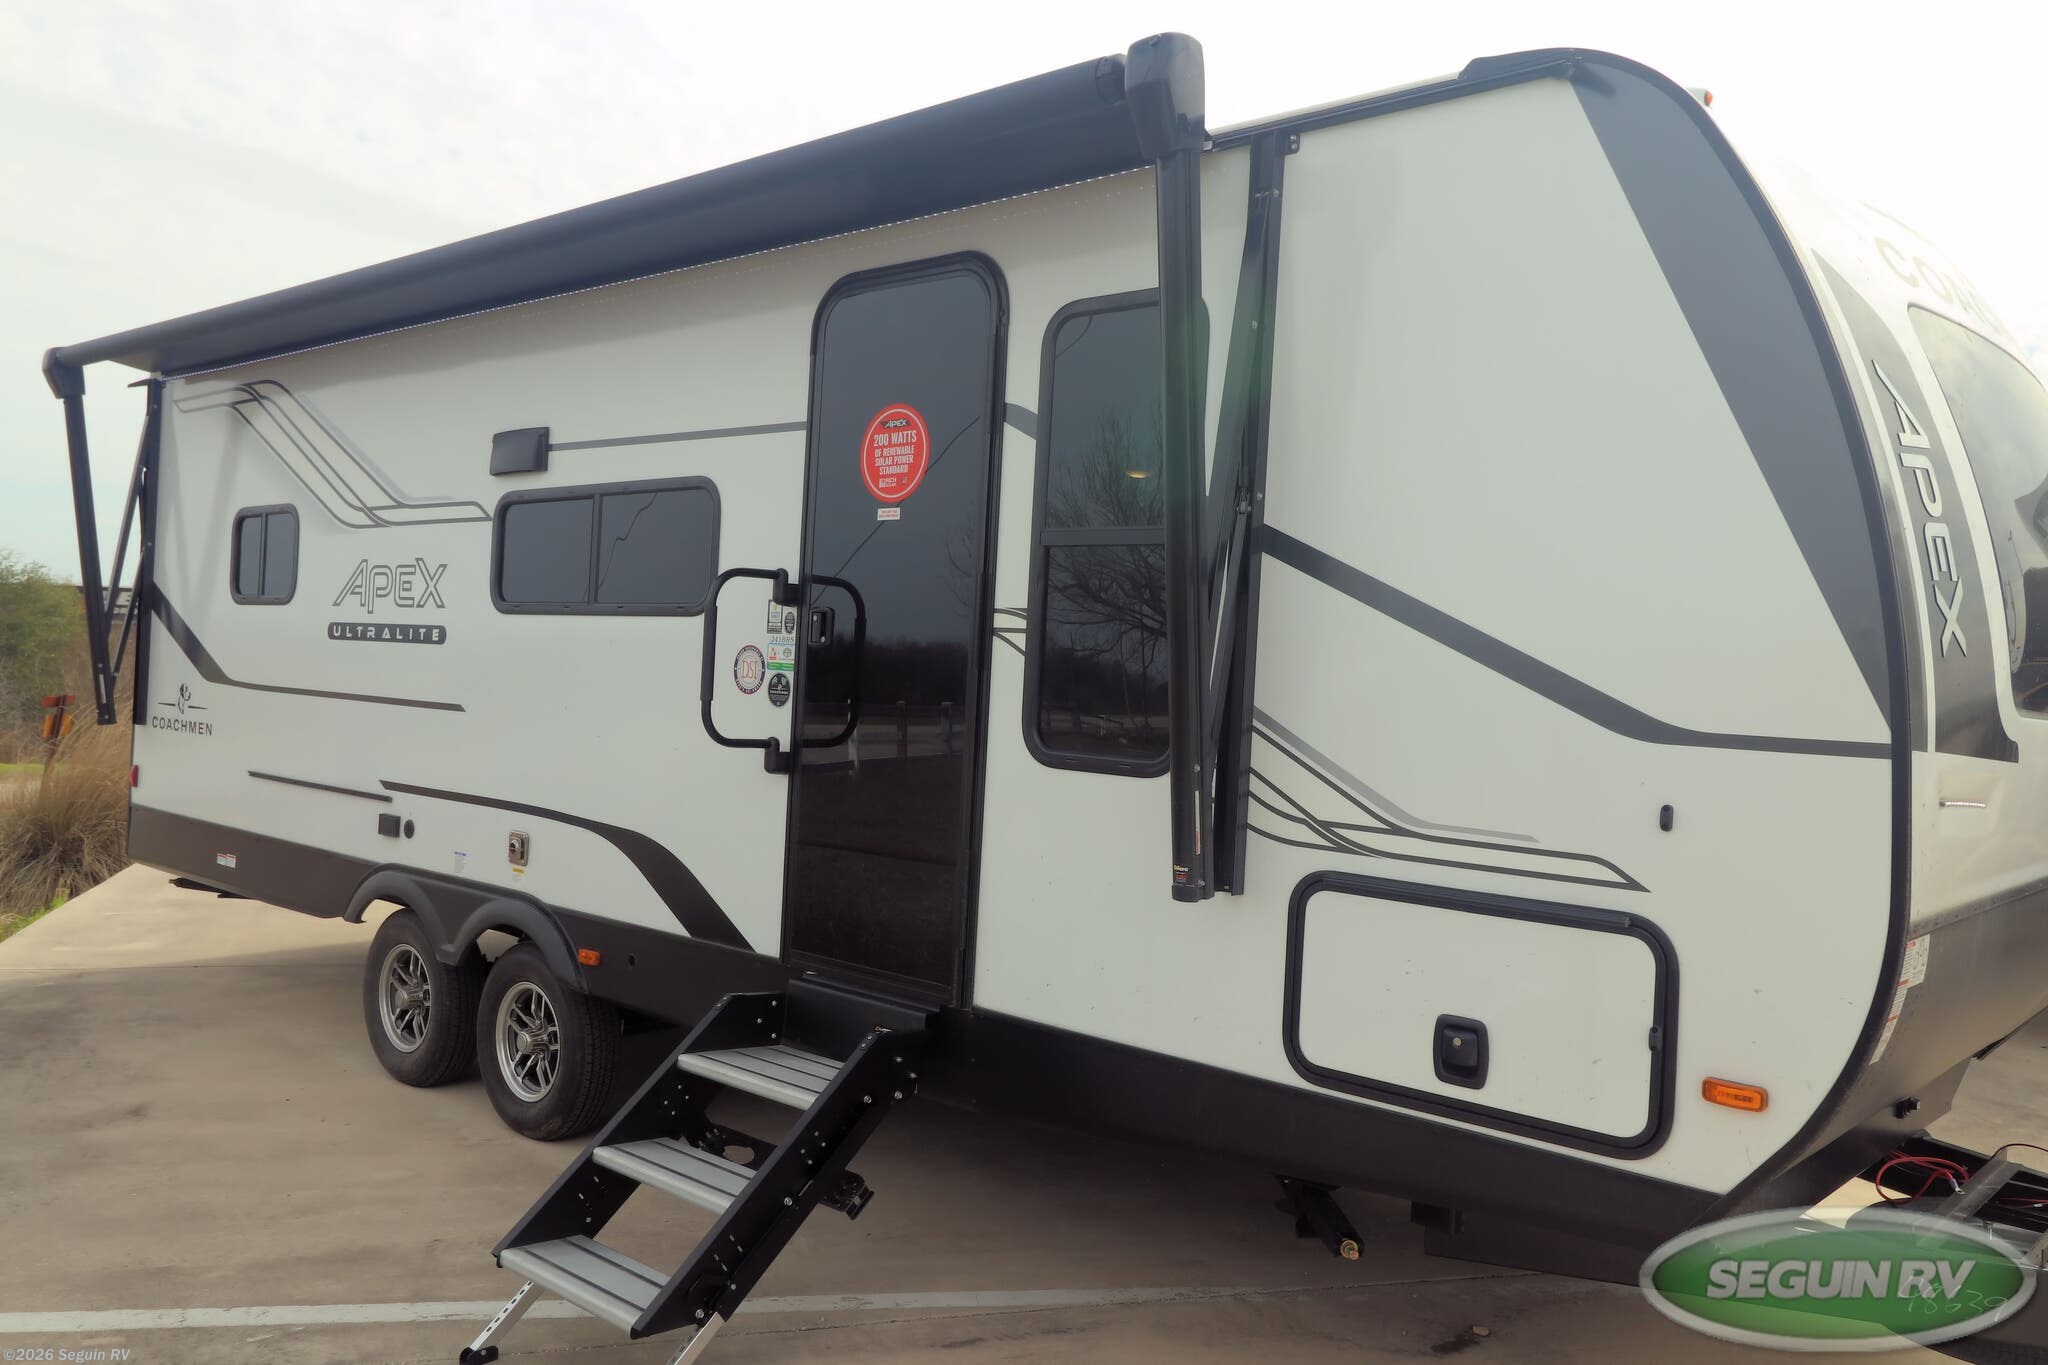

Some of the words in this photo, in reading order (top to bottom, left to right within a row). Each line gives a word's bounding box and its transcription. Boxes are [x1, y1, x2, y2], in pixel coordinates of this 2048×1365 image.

[885, 419, 908, 429] APEX
[874, 433, 889, 447] 200
[891, 430, 917, 446] WATTS
[875, 448, 882, 458] OF
[883, 445, 915, 457] RENEWABLE
[875, 457, 893, 467] SOLAR
[893, 455, 914, 465] POWER
[879, 465, 909, 475] STANDARD
[1871, 359, 1968, 658] APEX
[332, 557, 448, 614] APEX
[152, 716, 213, 736] COACHMEN
